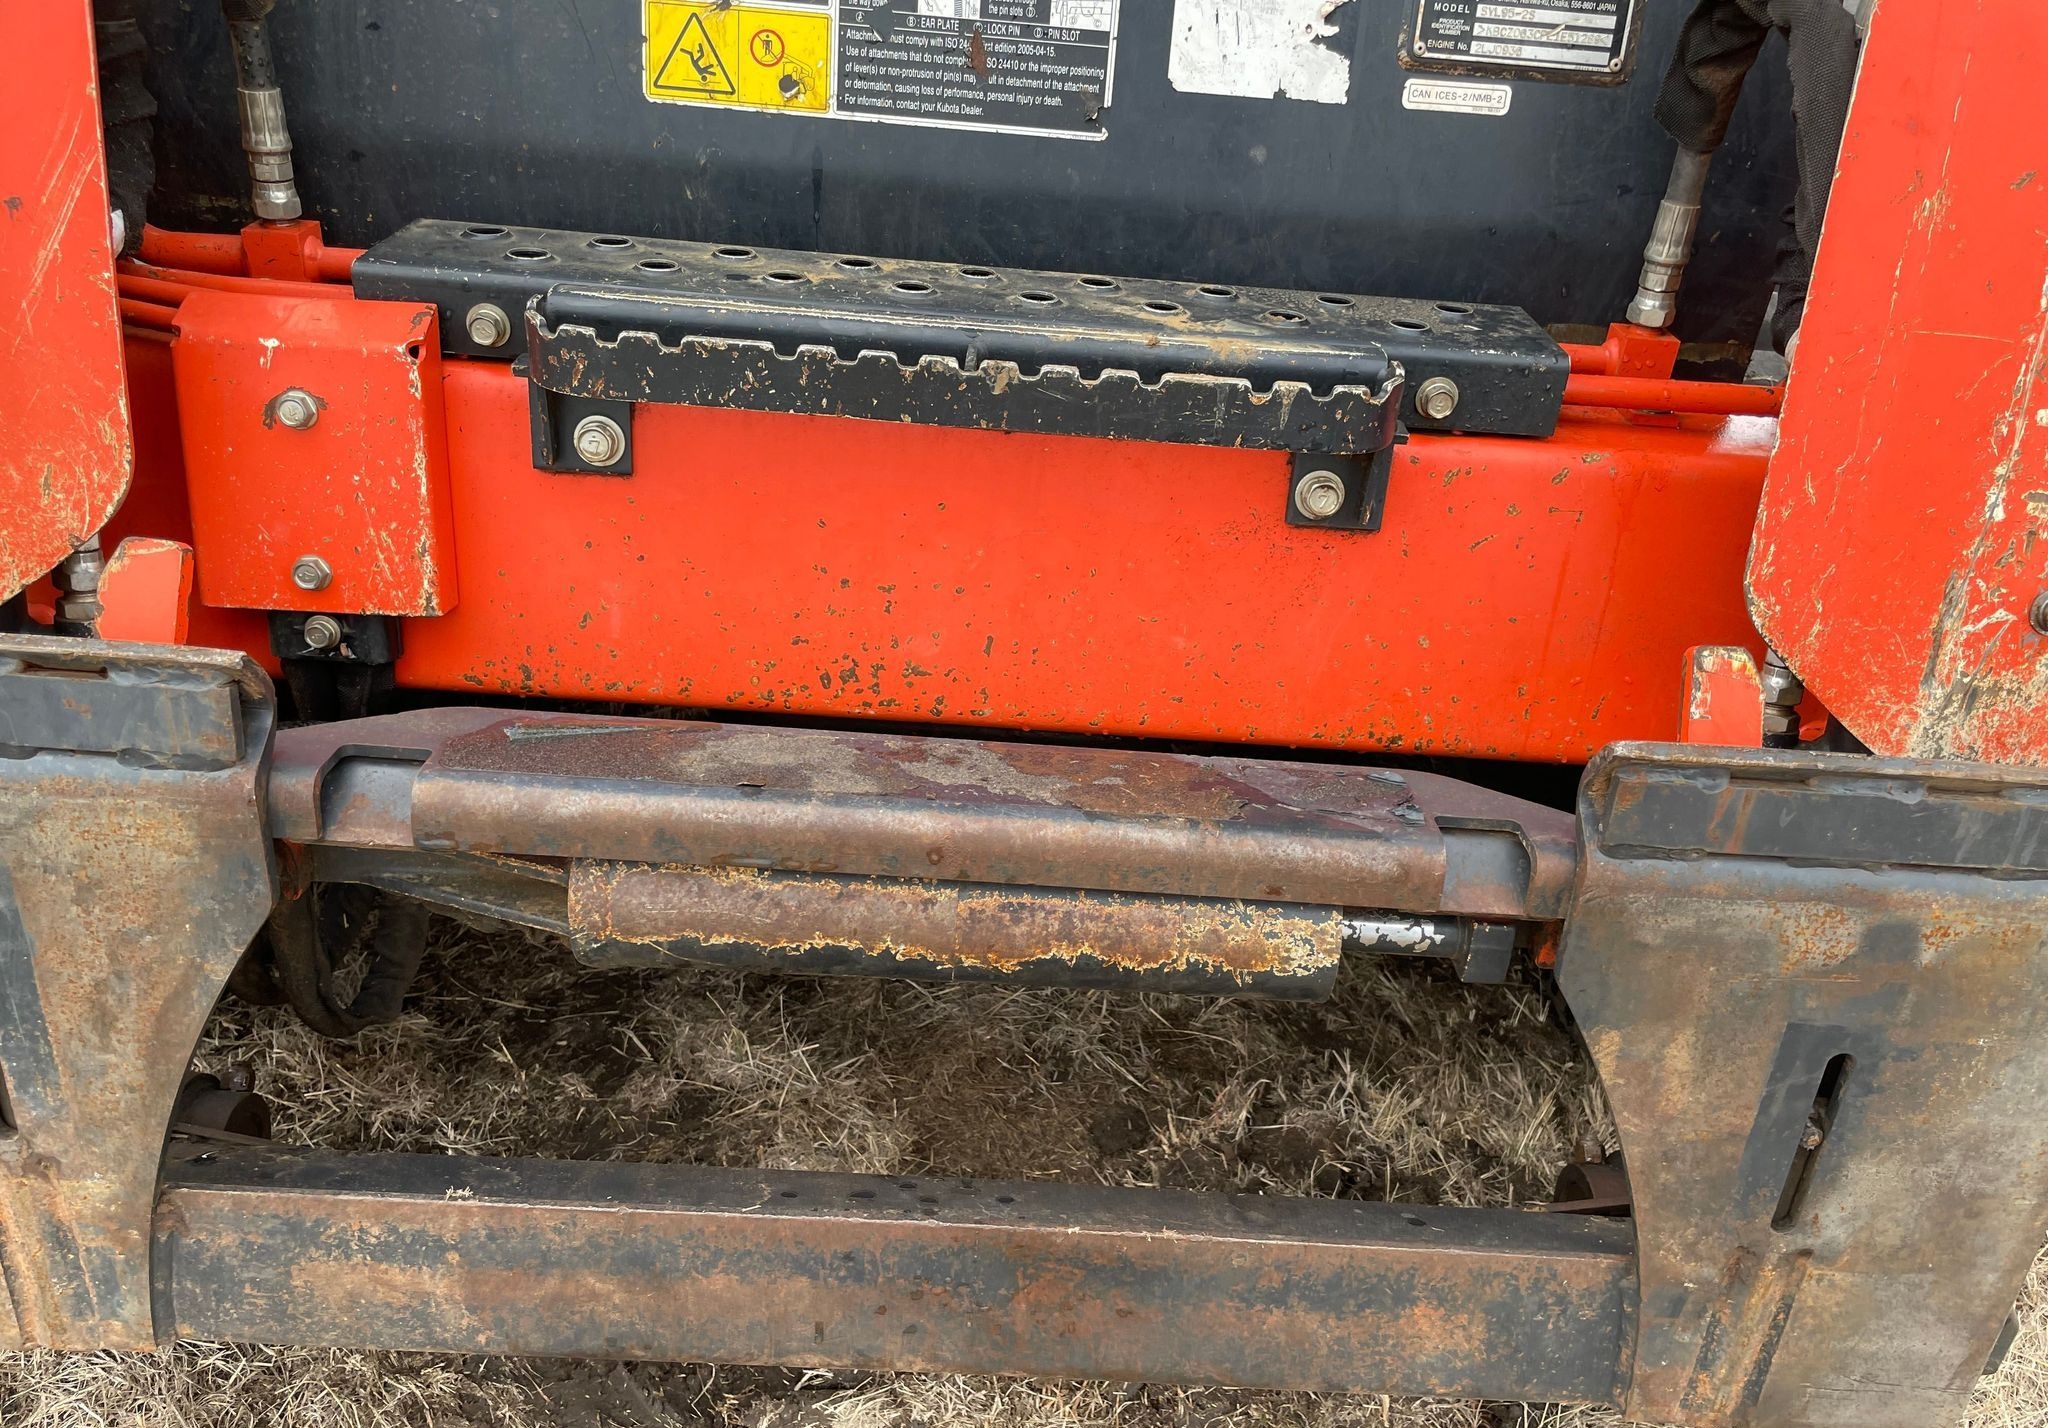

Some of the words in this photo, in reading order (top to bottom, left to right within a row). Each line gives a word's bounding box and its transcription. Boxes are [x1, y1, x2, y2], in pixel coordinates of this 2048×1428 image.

[988, 4, 998, 14] the
[999, 4, 1009, 17] pin
[1010, 5, 1024, 17] slots
[1433, 2, 1471, 14] MODEL
[1597, 2, 1617, 12] JAPAN
[920, 17, 937, 29] EAR
[937, 18, 960, 31] PLATE
[1430, 22, 1471, 32] IDENTIFICATION
[1438, 17, 1465, 25] PRODUCT
[987, 23, 1007, 36] LOCK
[1007, 25, 1021, 37] PIN
[1047, 29, 1061, 40] PIN
[1061, 30, 1081, 42] SLOT
[1438, 28, 1462, 36] NUMBER
[905, 35, 929, 48] comply
[930, 37, 944, 48] with
[945, 37, 958, 49] ISO
[994, 42, 1017, 54] edition
[1017, 43, 1057, 57] 2005-04-15.
[1427, 39, 1456, 50] ENGINE
[1457, 43, 1469, 51] No.
[845, 46, 859, 57] Use
[860, 47, 868, 57] of
[868, 48, 908, 61] attachments
[909, 50, 922, 61] that
[923, 52, 932, 63] do
[933, 53, 944, 63] not
[998, 58, 1019, 71] 24410
[1019, 62, 1028, 71] or
[1028, 62, 1039, 72] the
[1040, 62, 1069, 76] improper
[1069, 65, 1105, 80] positioning
[845, 63, 853, 73] of
[853, 63, 879, 76] lever(s)
[879, 66, 887, 75] or
[887, 67, 935, 80] non-protrusion
[935, 69, 943, 80] of
[943, 71, 963, 83] pin(s)
[963, 74, 977, 86] may
[997, 75, 1005, 85] in
[1005, 76, 1043, 88] detachment
[1044, 79, 1052, 89] of
[1052, 79, 1063, 90] the
[1063, 81, 1100, 94] attachment
[844, 79, 852, 88] or
[853, 80, 894, 93] deformation,
[894, 84, 920, 97] causing
[921, 84, 935, 96] loss
[935, 86, 943, 97] of
[943, 87, 986, 101] performance,
[986, 90, 1015, 103] personal
[1015, 93, 1037, 106] injury
[1043, 95, 1064, 106] death.
[1411, 89, 1432, 99] CAN
[1435, 90, 1503, 104] ICES-2/NMB-2
[844, 93, 857, 105] For
[857, 95, 895, 109] information,
[896, 98, 920, 110] contact
[920, 101, 936, 113] your
[936, 102, 960, 114] Kubota
[960, 104, 985, 117] Dealer.
